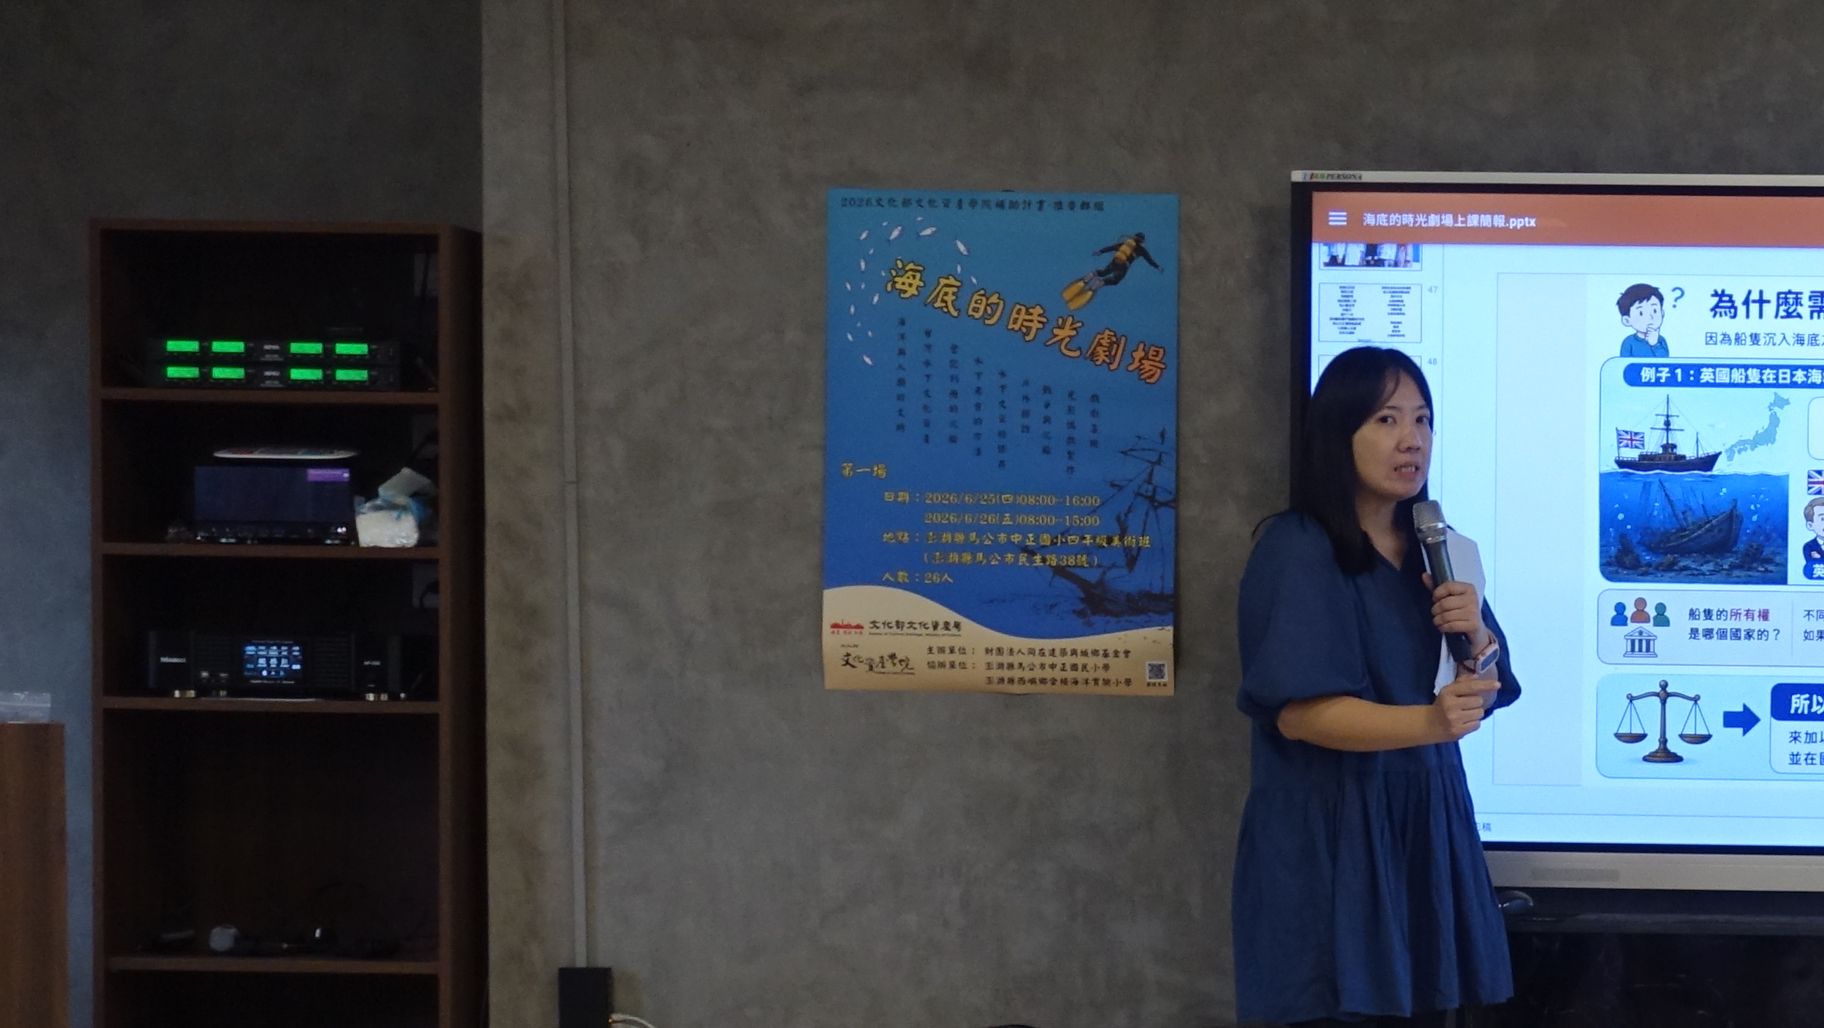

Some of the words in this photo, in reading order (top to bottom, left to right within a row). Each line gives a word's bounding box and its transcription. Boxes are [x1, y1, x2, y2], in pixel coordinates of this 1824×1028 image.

[1363, 212, 1537, 230] 海底的時光劇場上課簡報.pptx
[1427, 285, 1439, 294] 47
[885, 257, 1168, 385] 海底的時光劇場
[841, 462, 887, 479] 第一場
[1688, 607, 1771, 622] 船隻的所有權
[1688, 627, 1781, 641] 是哪個國家的？
